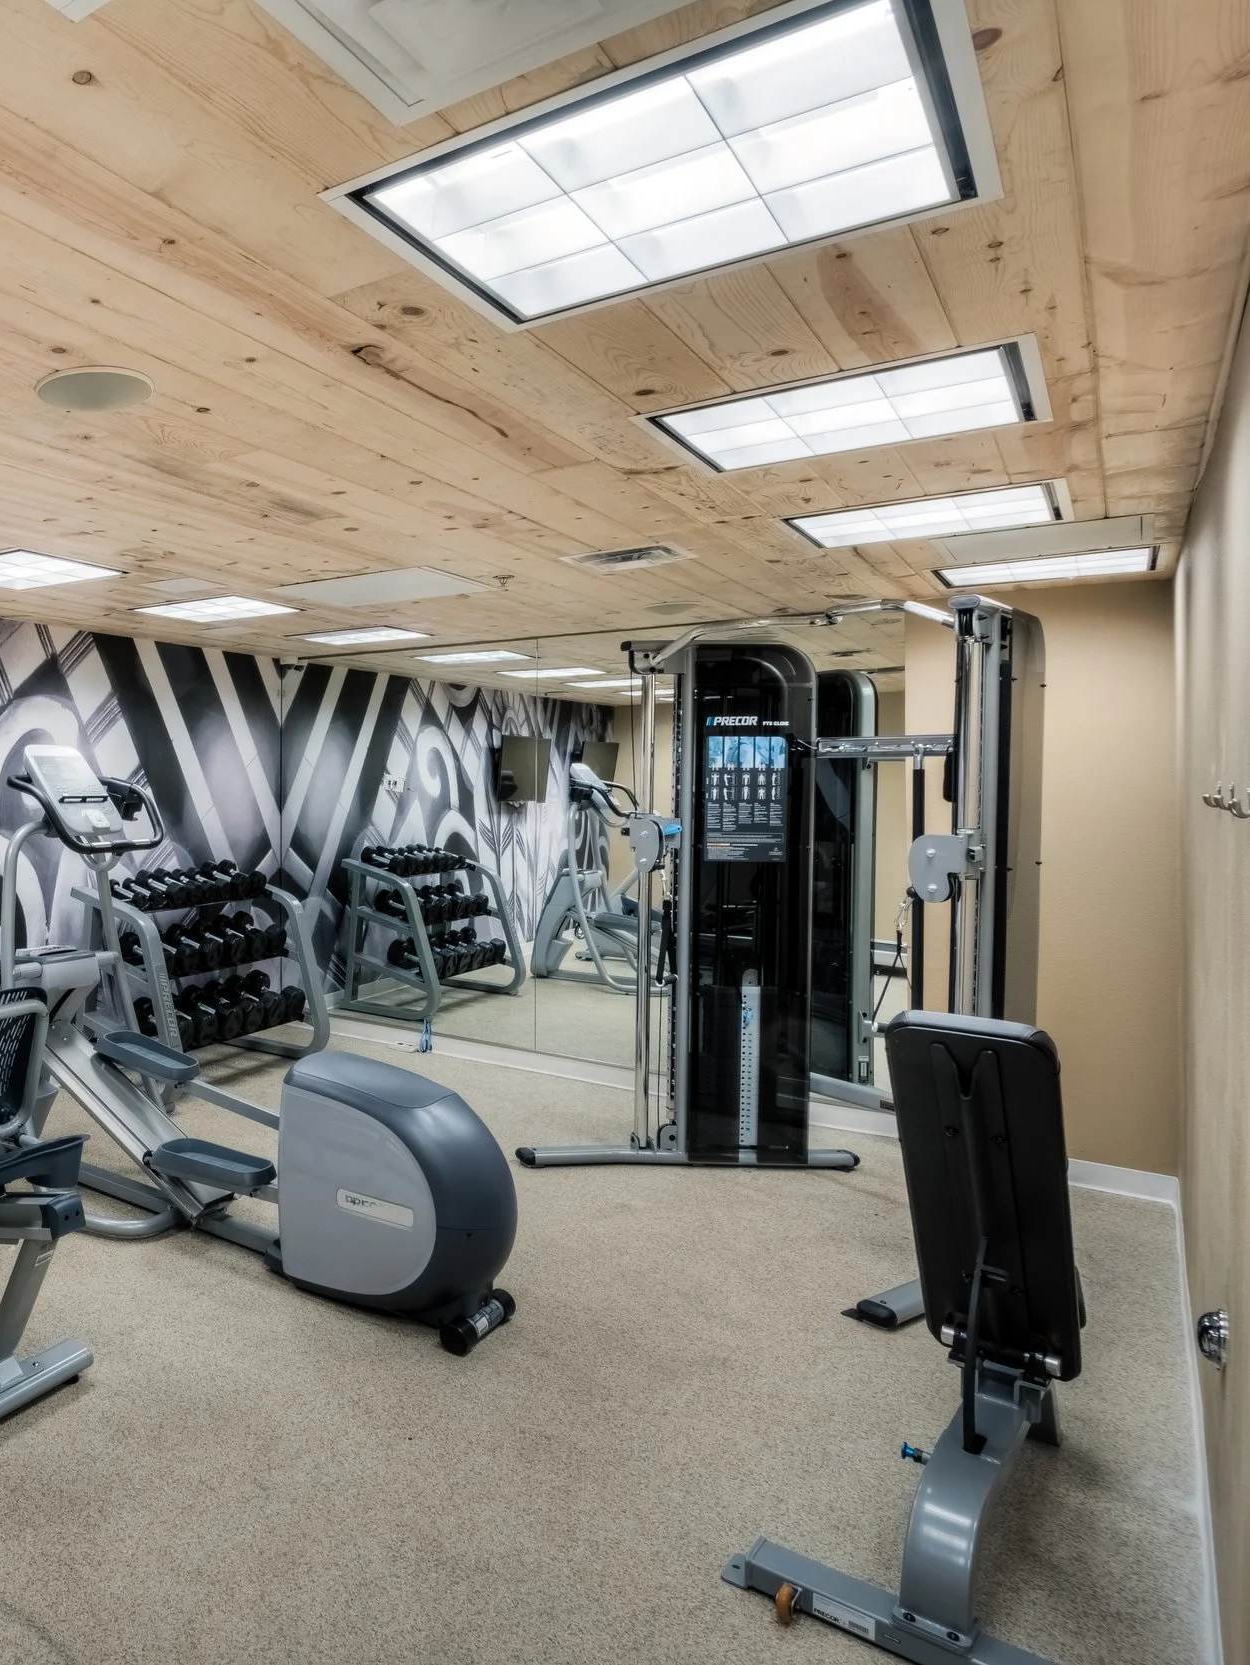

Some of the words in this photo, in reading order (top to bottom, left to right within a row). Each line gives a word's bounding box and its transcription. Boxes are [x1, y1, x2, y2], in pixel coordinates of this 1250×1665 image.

[713, 716, 758, 726] PRECOR
[160, 983, 178, 1038] PRECOR
[813, 1607, 841, 1624] PRECOR
